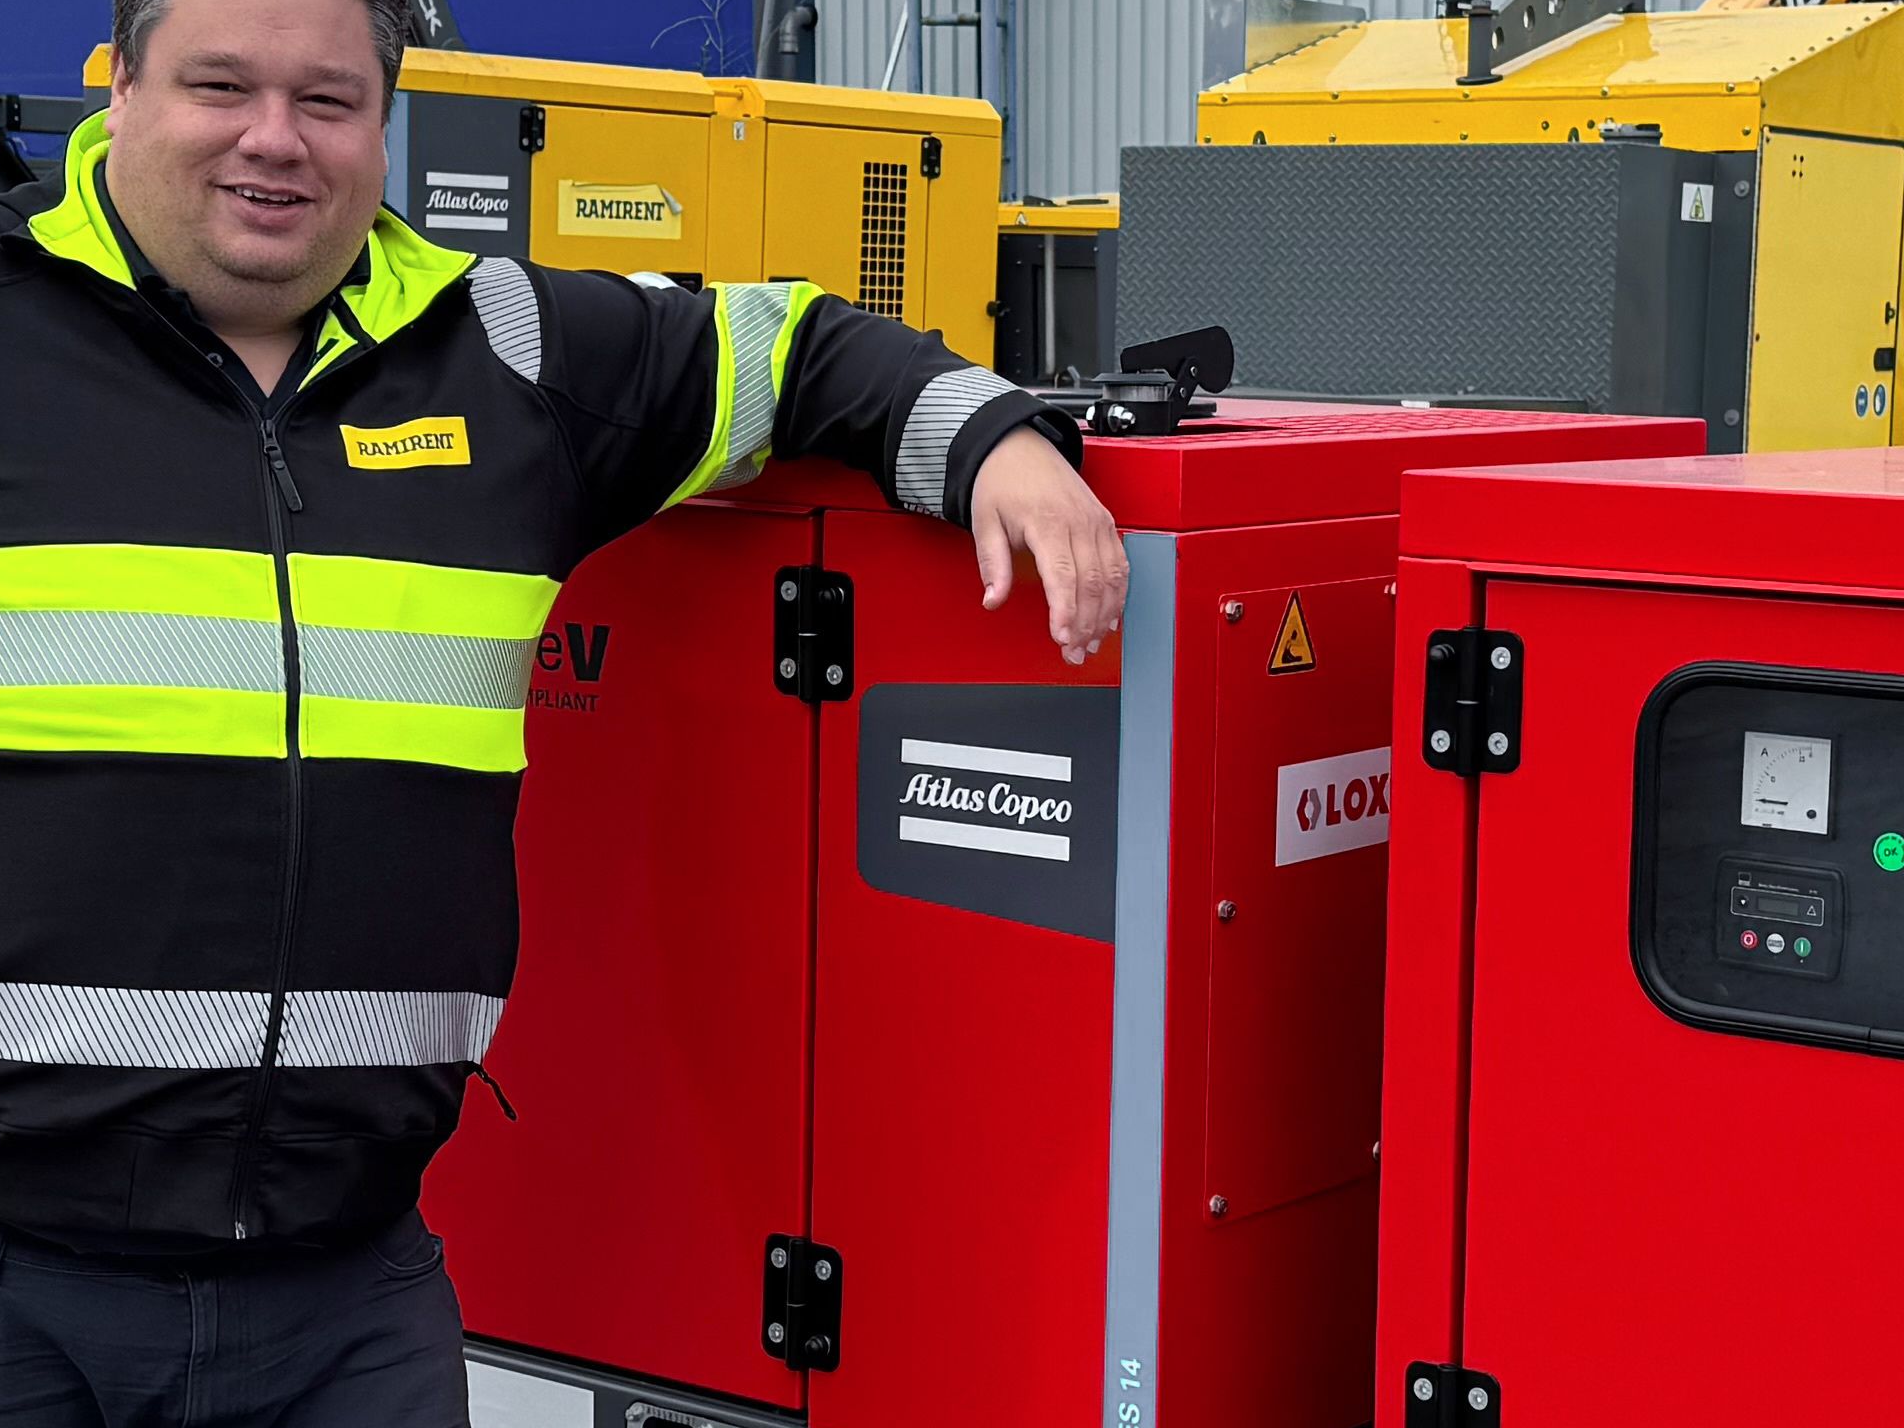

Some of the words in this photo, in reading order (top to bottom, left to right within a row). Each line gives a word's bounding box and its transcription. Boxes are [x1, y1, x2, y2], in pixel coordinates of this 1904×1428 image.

[426, 189, 467, 210] Atlas
[468, 192, 509, 214] Copco
[576, 198, 665, 221] RAMIRENT
[356, 433, 454, 456] RAMIRENT
[527, 688, 600, 711] PLIANT
[899, 773, 985, 813] Atlas
[987, 782, 1072, 825] Copco
[1325, 772, 1390, 826] LOX
[1883, 847, 1898, 857] OK
[1119, 1357, 1142, 1391] 14
